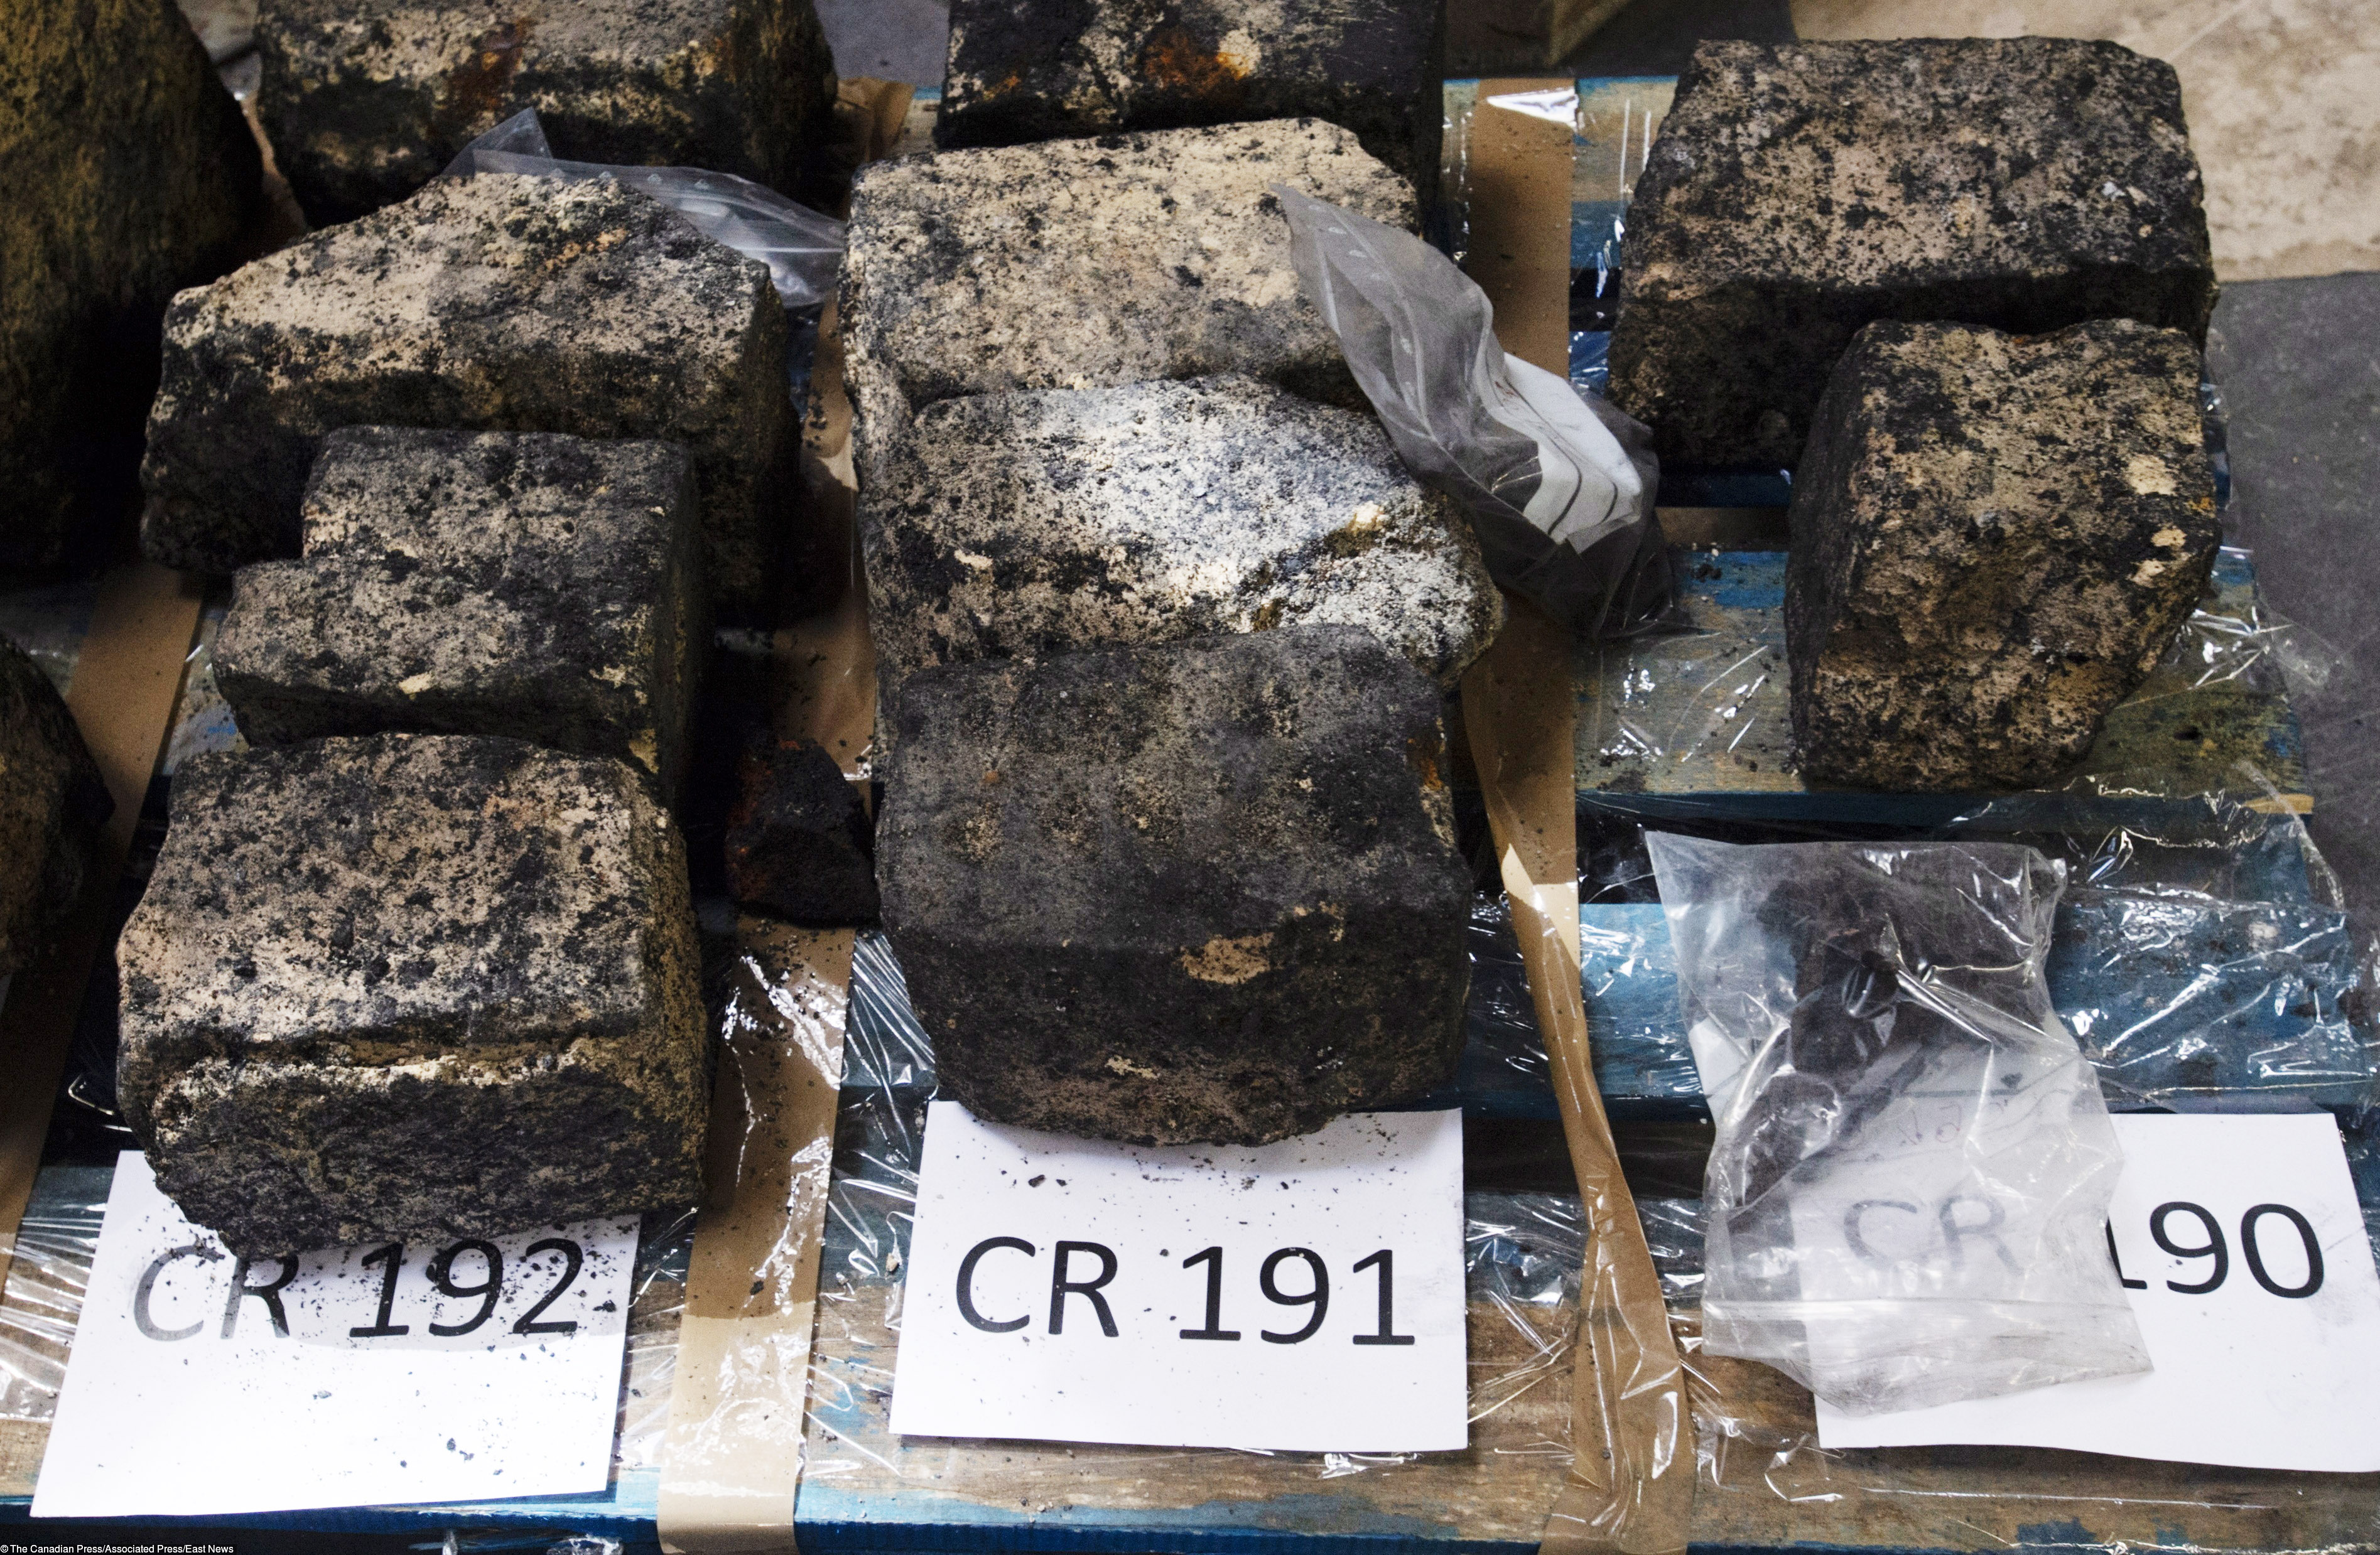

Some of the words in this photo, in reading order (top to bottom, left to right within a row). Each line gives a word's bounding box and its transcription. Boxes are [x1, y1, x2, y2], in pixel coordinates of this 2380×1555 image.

[1843, 1194, 2025, 1277] CR
[133, 1244, 300, 1342] CR
[349, 1237, 583, 1338] 192
[955, 1235, 1120, 1338] CR
[1179, 1246, 1415, 1346] 191
